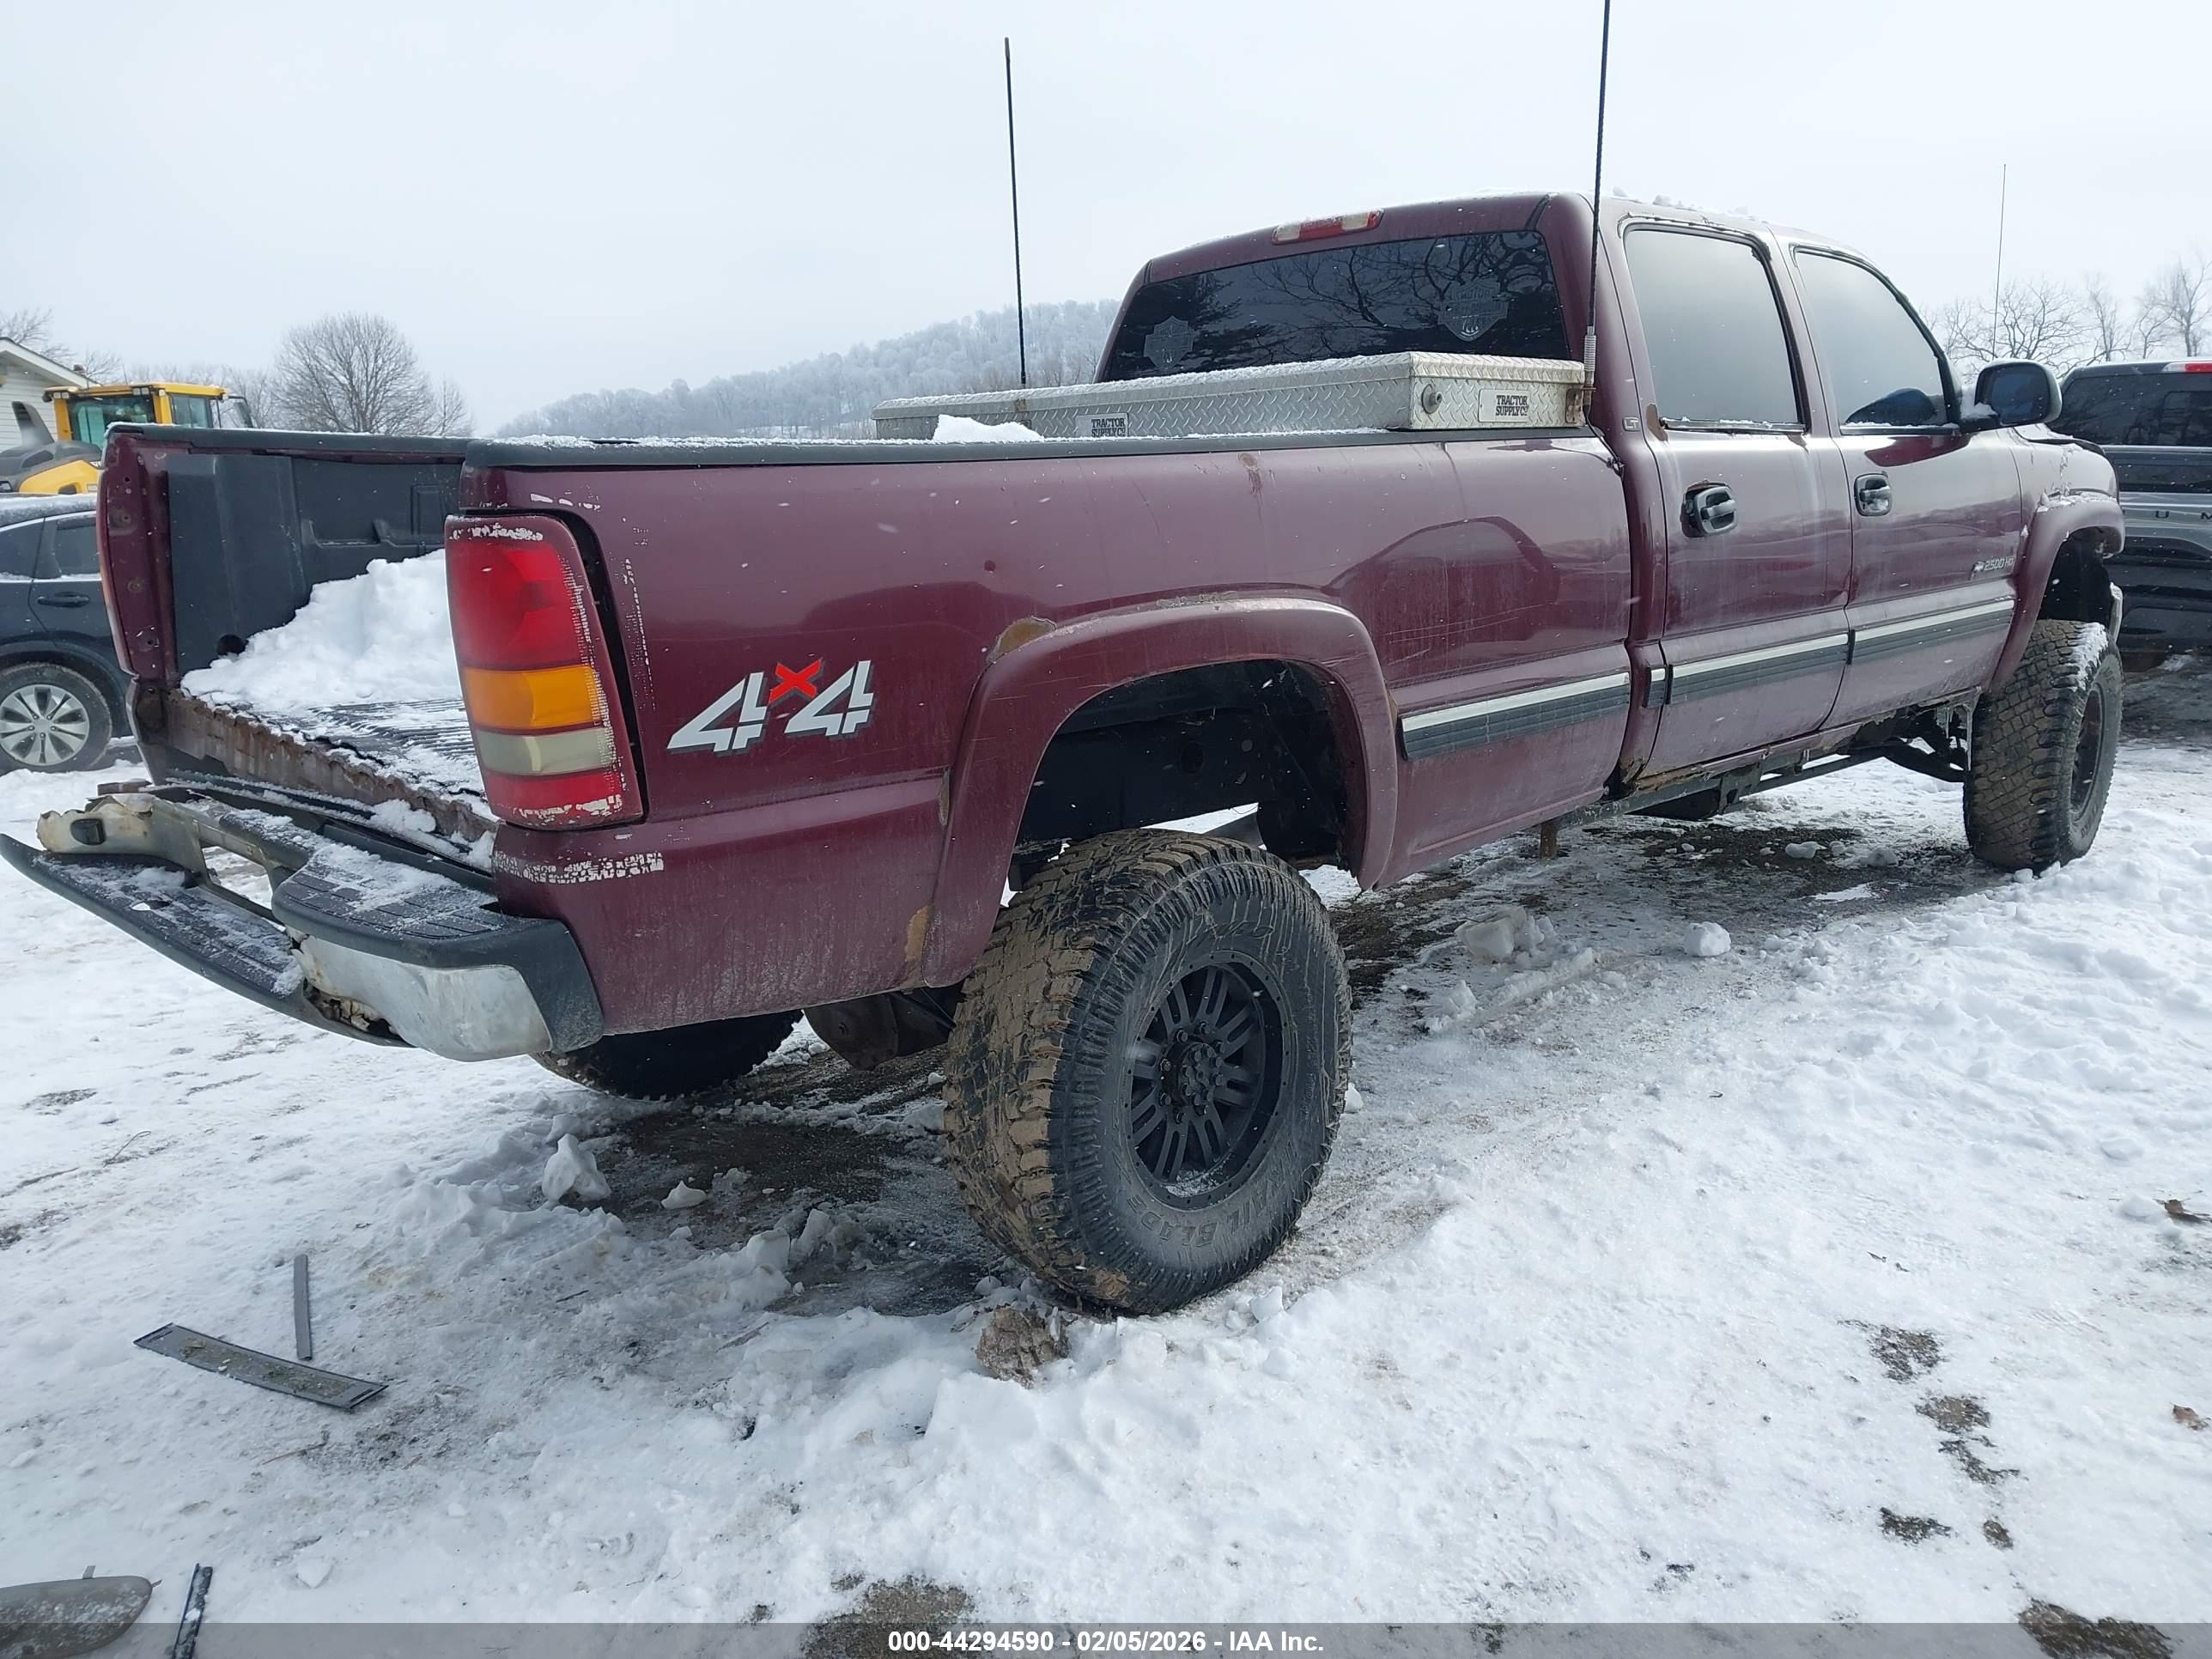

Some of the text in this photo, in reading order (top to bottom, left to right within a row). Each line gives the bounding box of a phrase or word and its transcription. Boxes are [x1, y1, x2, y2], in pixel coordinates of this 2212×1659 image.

[1496, 395, 1528, 405] TRACTOR
[1495, 405, 1520, 416] SUPPLY
[1091, 417, 1126, 428] TRACTOR
[1625, 418, 1639, 429] LT
[1091, 428, 1116, 437] SUPPLY
[1984, 558, 2005, 571] 2500
[1125, 1194, 1220, 1249] BLADE
